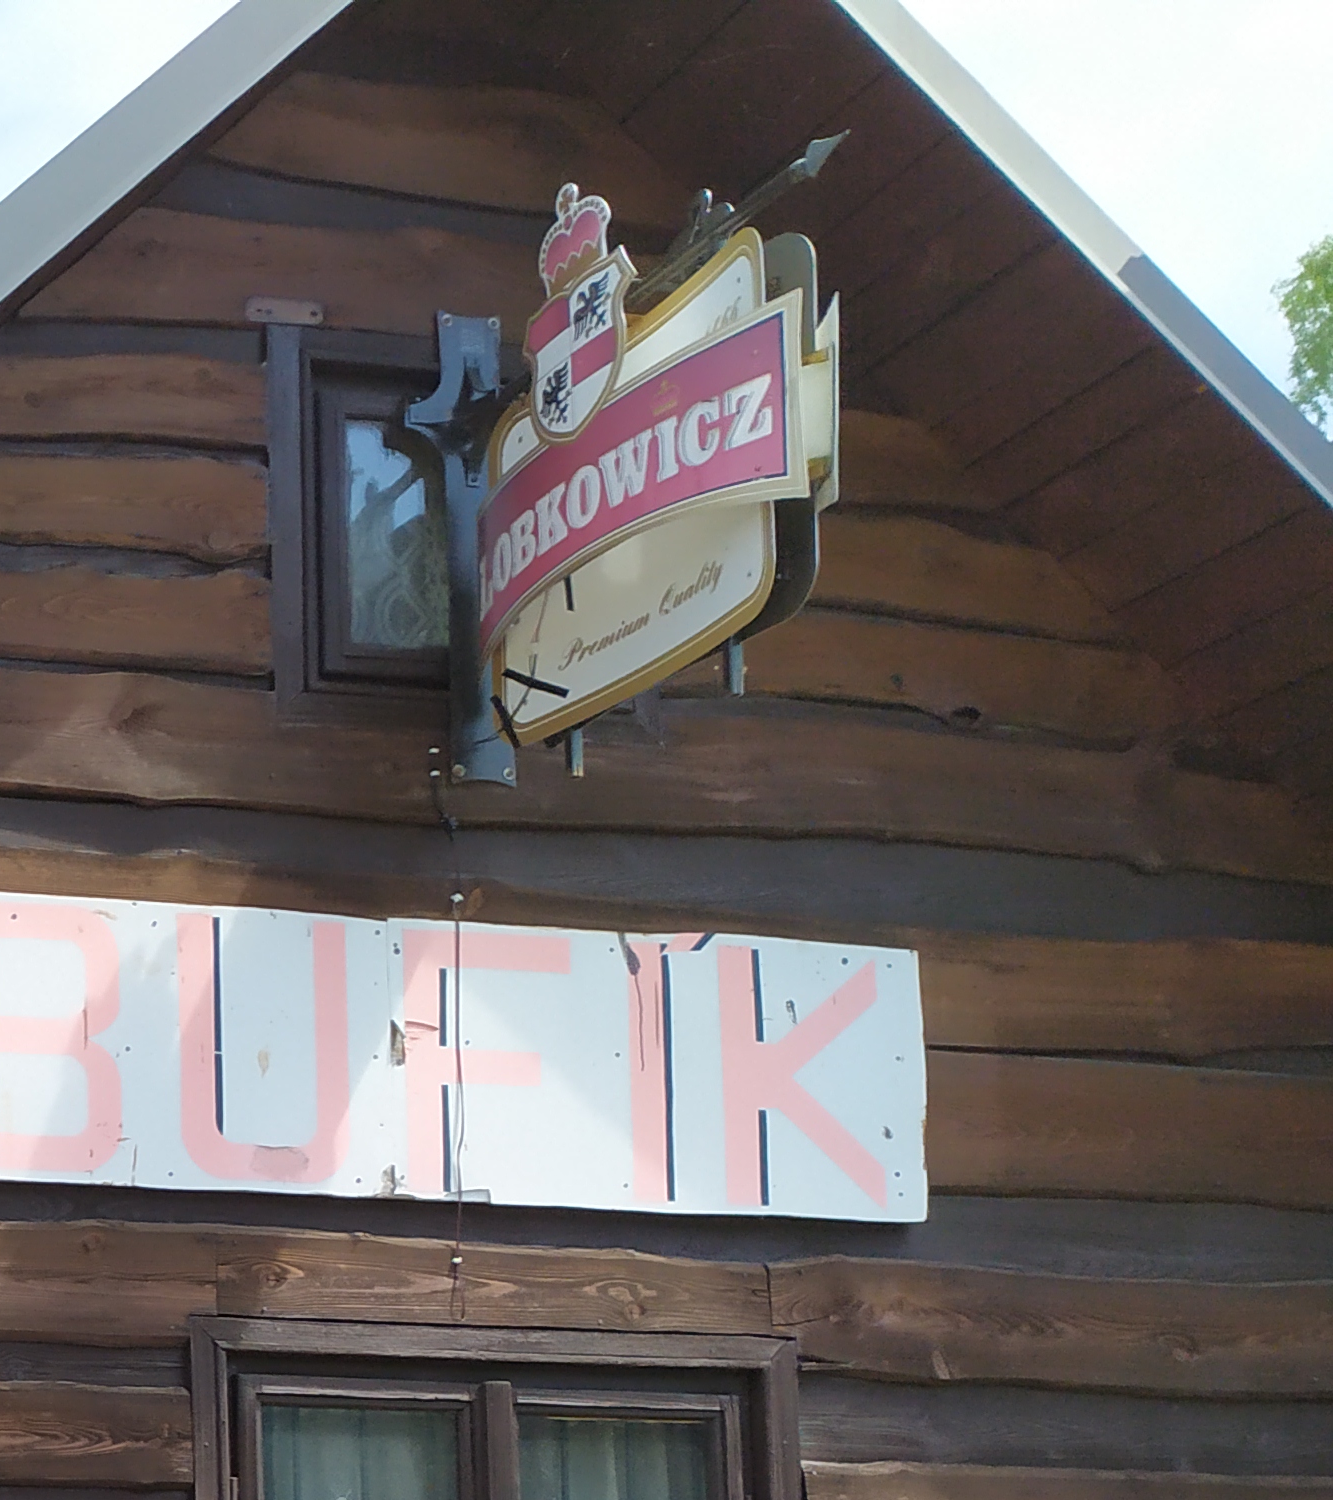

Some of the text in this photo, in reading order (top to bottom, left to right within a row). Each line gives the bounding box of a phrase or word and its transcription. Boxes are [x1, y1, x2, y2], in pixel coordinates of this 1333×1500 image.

[479, 372, 773, 622] LOBKOWICZ
[557, 558, 725, 671] Premium Quality
